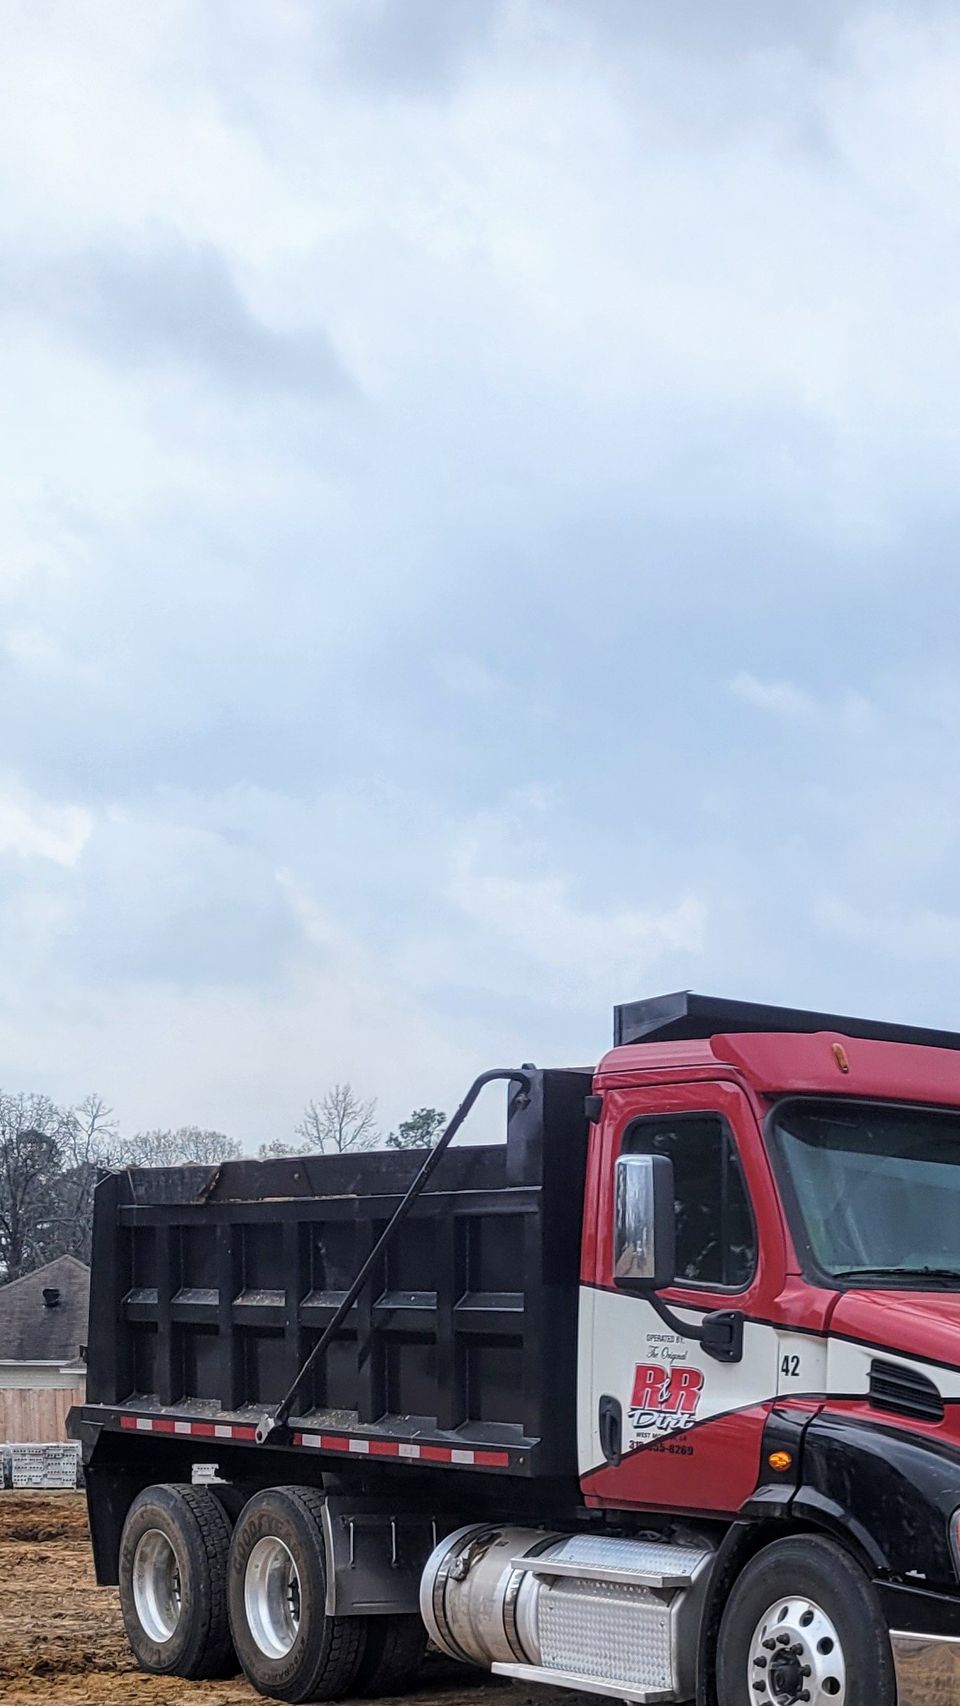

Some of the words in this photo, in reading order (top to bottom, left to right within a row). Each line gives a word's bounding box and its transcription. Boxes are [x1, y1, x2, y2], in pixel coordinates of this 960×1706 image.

[661, 1346, 688, 1364] Original
[781, 1355, 800, 1377] 42
[630, 1362, 705, 1414] R&R
[628, 1410, 696, 1431] Dirt
